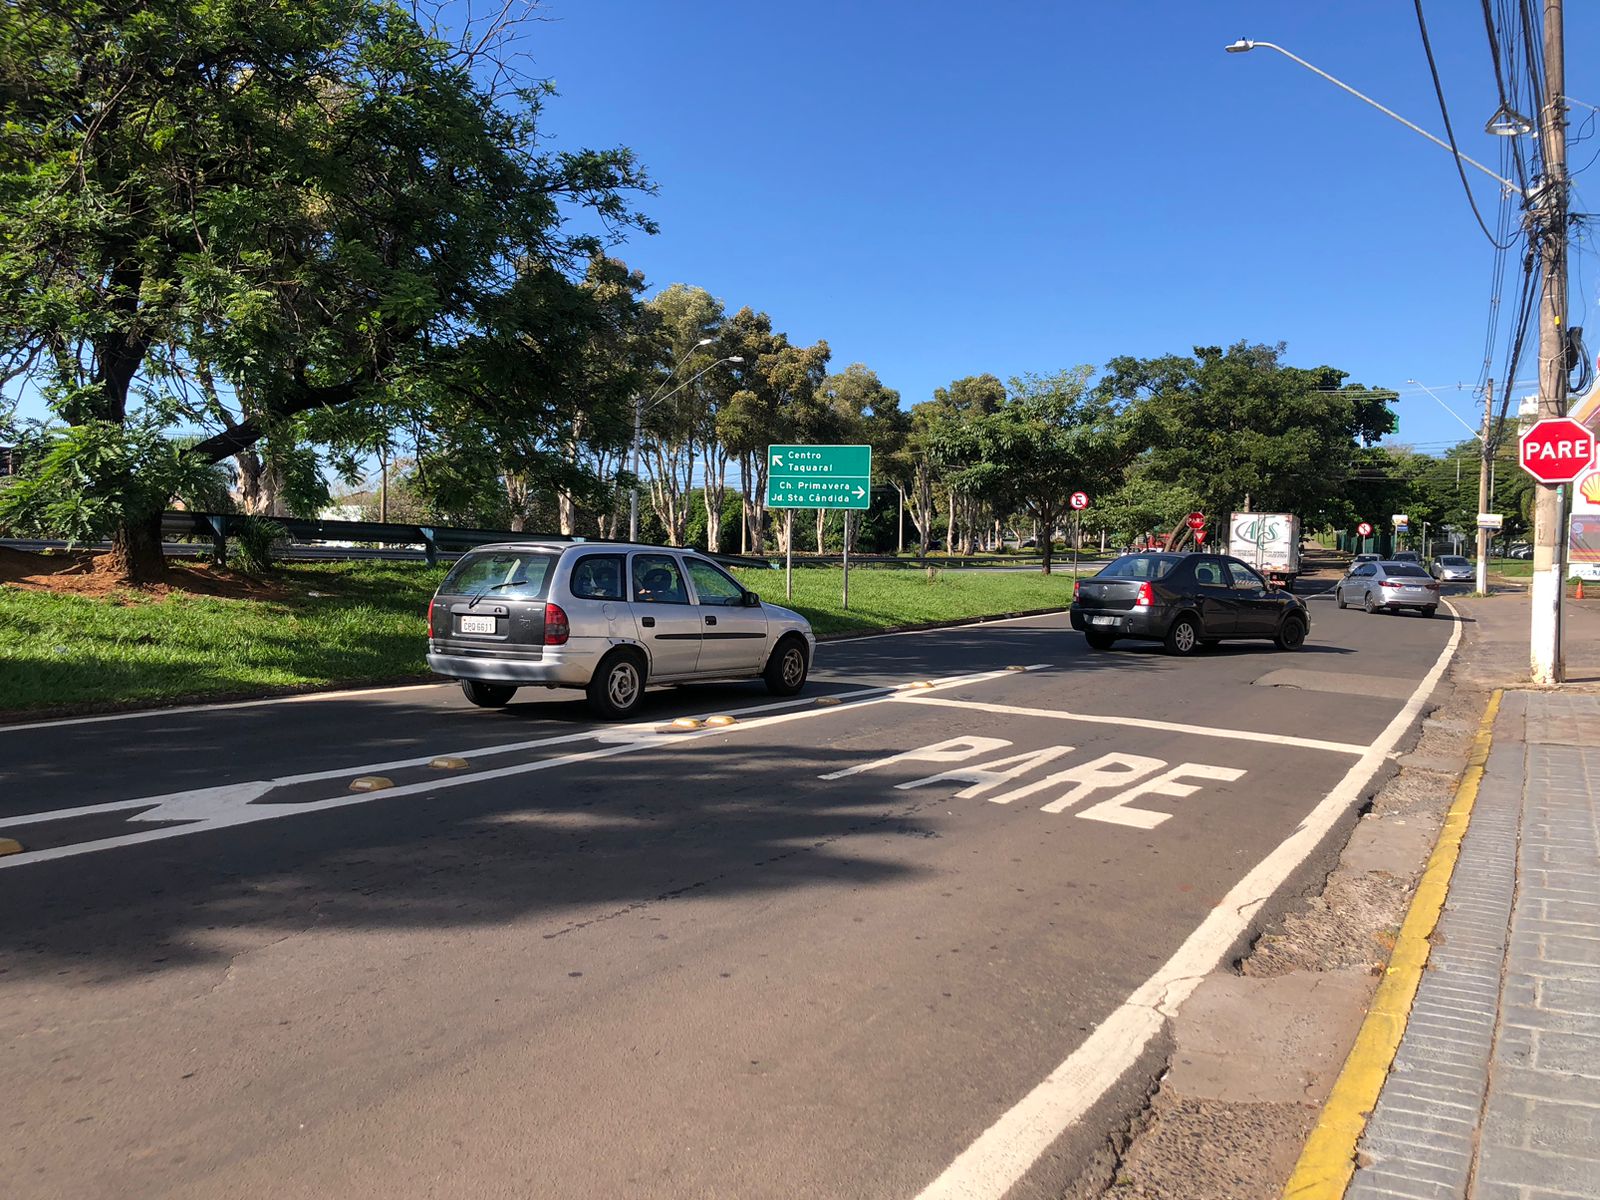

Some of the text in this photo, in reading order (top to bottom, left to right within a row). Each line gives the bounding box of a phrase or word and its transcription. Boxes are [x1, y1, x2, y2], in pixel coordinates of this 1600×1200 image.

[1525, 439, 1589, 460] PARE
[788, 451, 822, 459] Centro
[788, 463, 833, 472] Taquaral
[779, 481, 850, 490] Ch. Primavera
[771, 493, 784, 501] Jd.
[808, 493, 850, 502] Cândida
[817, 736, 1247, 829] PARE
